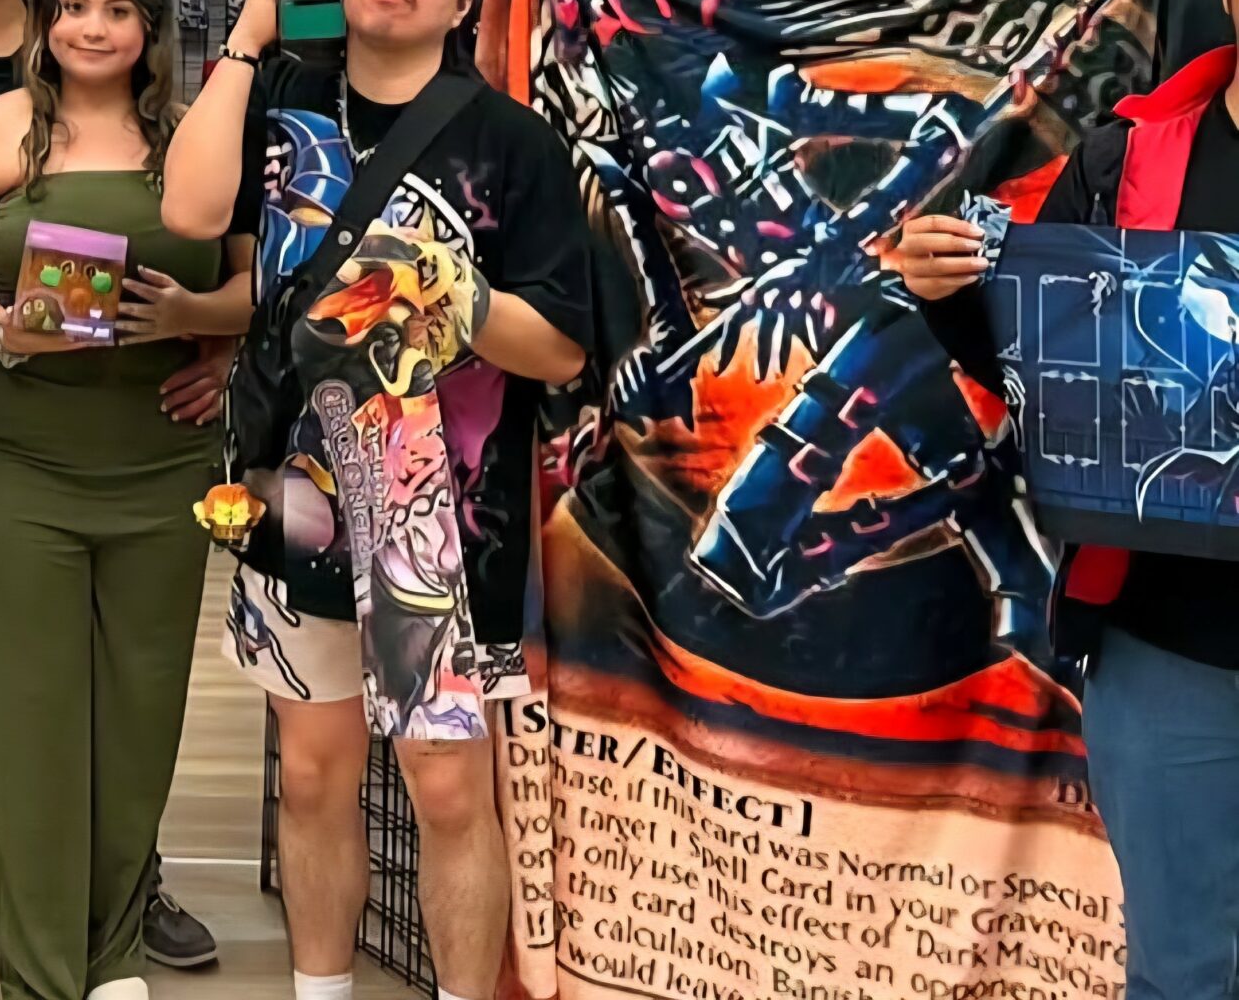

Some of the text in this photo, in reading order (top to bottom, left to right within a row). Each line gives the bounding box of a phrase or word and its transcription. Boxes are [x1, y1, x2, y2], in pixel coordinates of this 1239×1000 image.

[580, 806, 657, 844] target
[688, 831, 747, 884] Spell
[761, 867, 833, 906] Card
[846, 886, 876, 914] in
[889, 897, 960, 928] your
[584, 846, 644, 880] only
[652, 860, 699, 890] use
[708, 878, 753, 916] this
[761, 904, 851, 945] effect
[861, 917, 893, 949] of
[653, 786, 696, 825] this
[700, 817, 760, 855] card
[768, 840, 830, 871] was
[838, 850, 953, 889] Normal
[961, 875, 997, 899] or
[1003, 873, 1112, 923] Special
[568, 940, 656, 986] would
[569, 870, 618, 904] this
[632, 891, 696, 924] card
[711, 911, 837, 975] destroys
[855, 960, 894, 987] an
